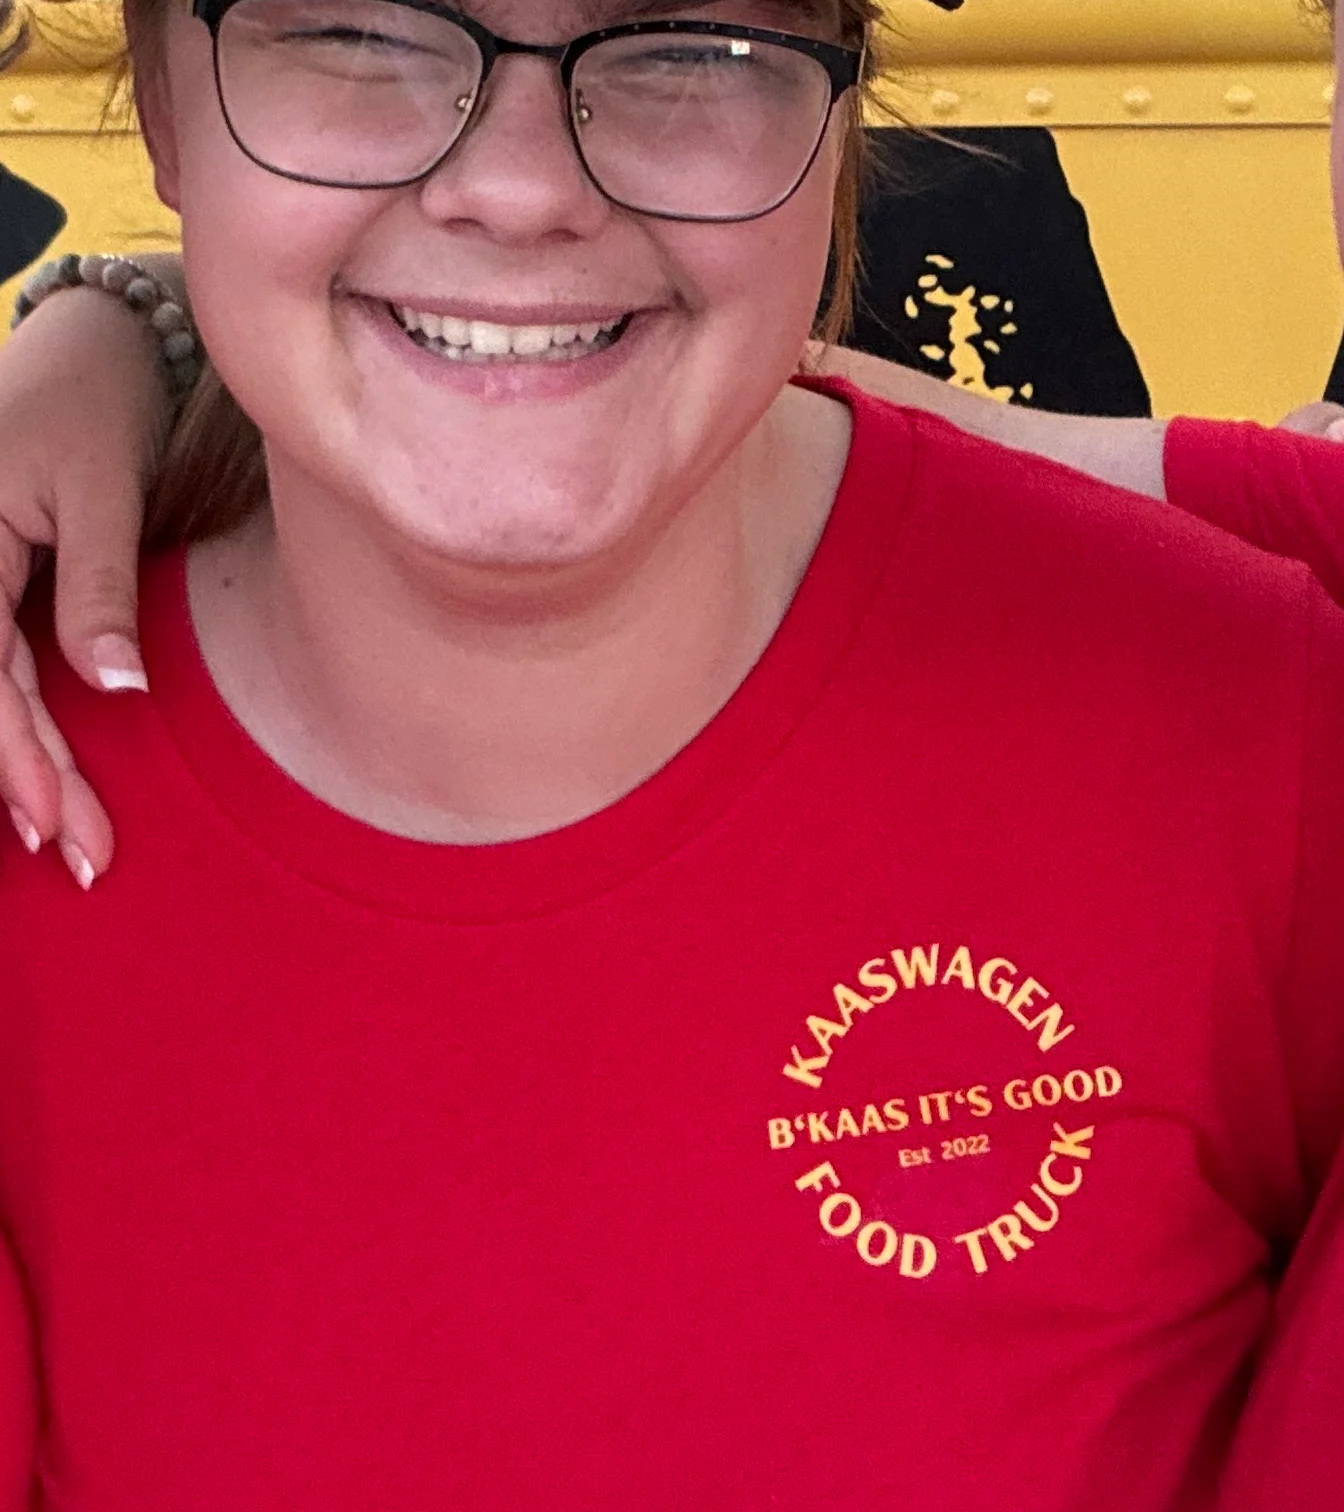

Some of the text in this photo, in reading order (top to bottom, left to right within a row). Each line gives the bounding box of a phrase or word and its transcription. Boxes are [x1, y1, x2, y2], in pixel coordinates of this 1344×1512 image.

[782, 943, 1075, 1088] KAASWAGEN
[1003, 1065, 1123, 1111] GOOD
[898, 1133, 991, 1169] Est 2022
[794, 1121, 1096, 1279] FOOD TRUCK
